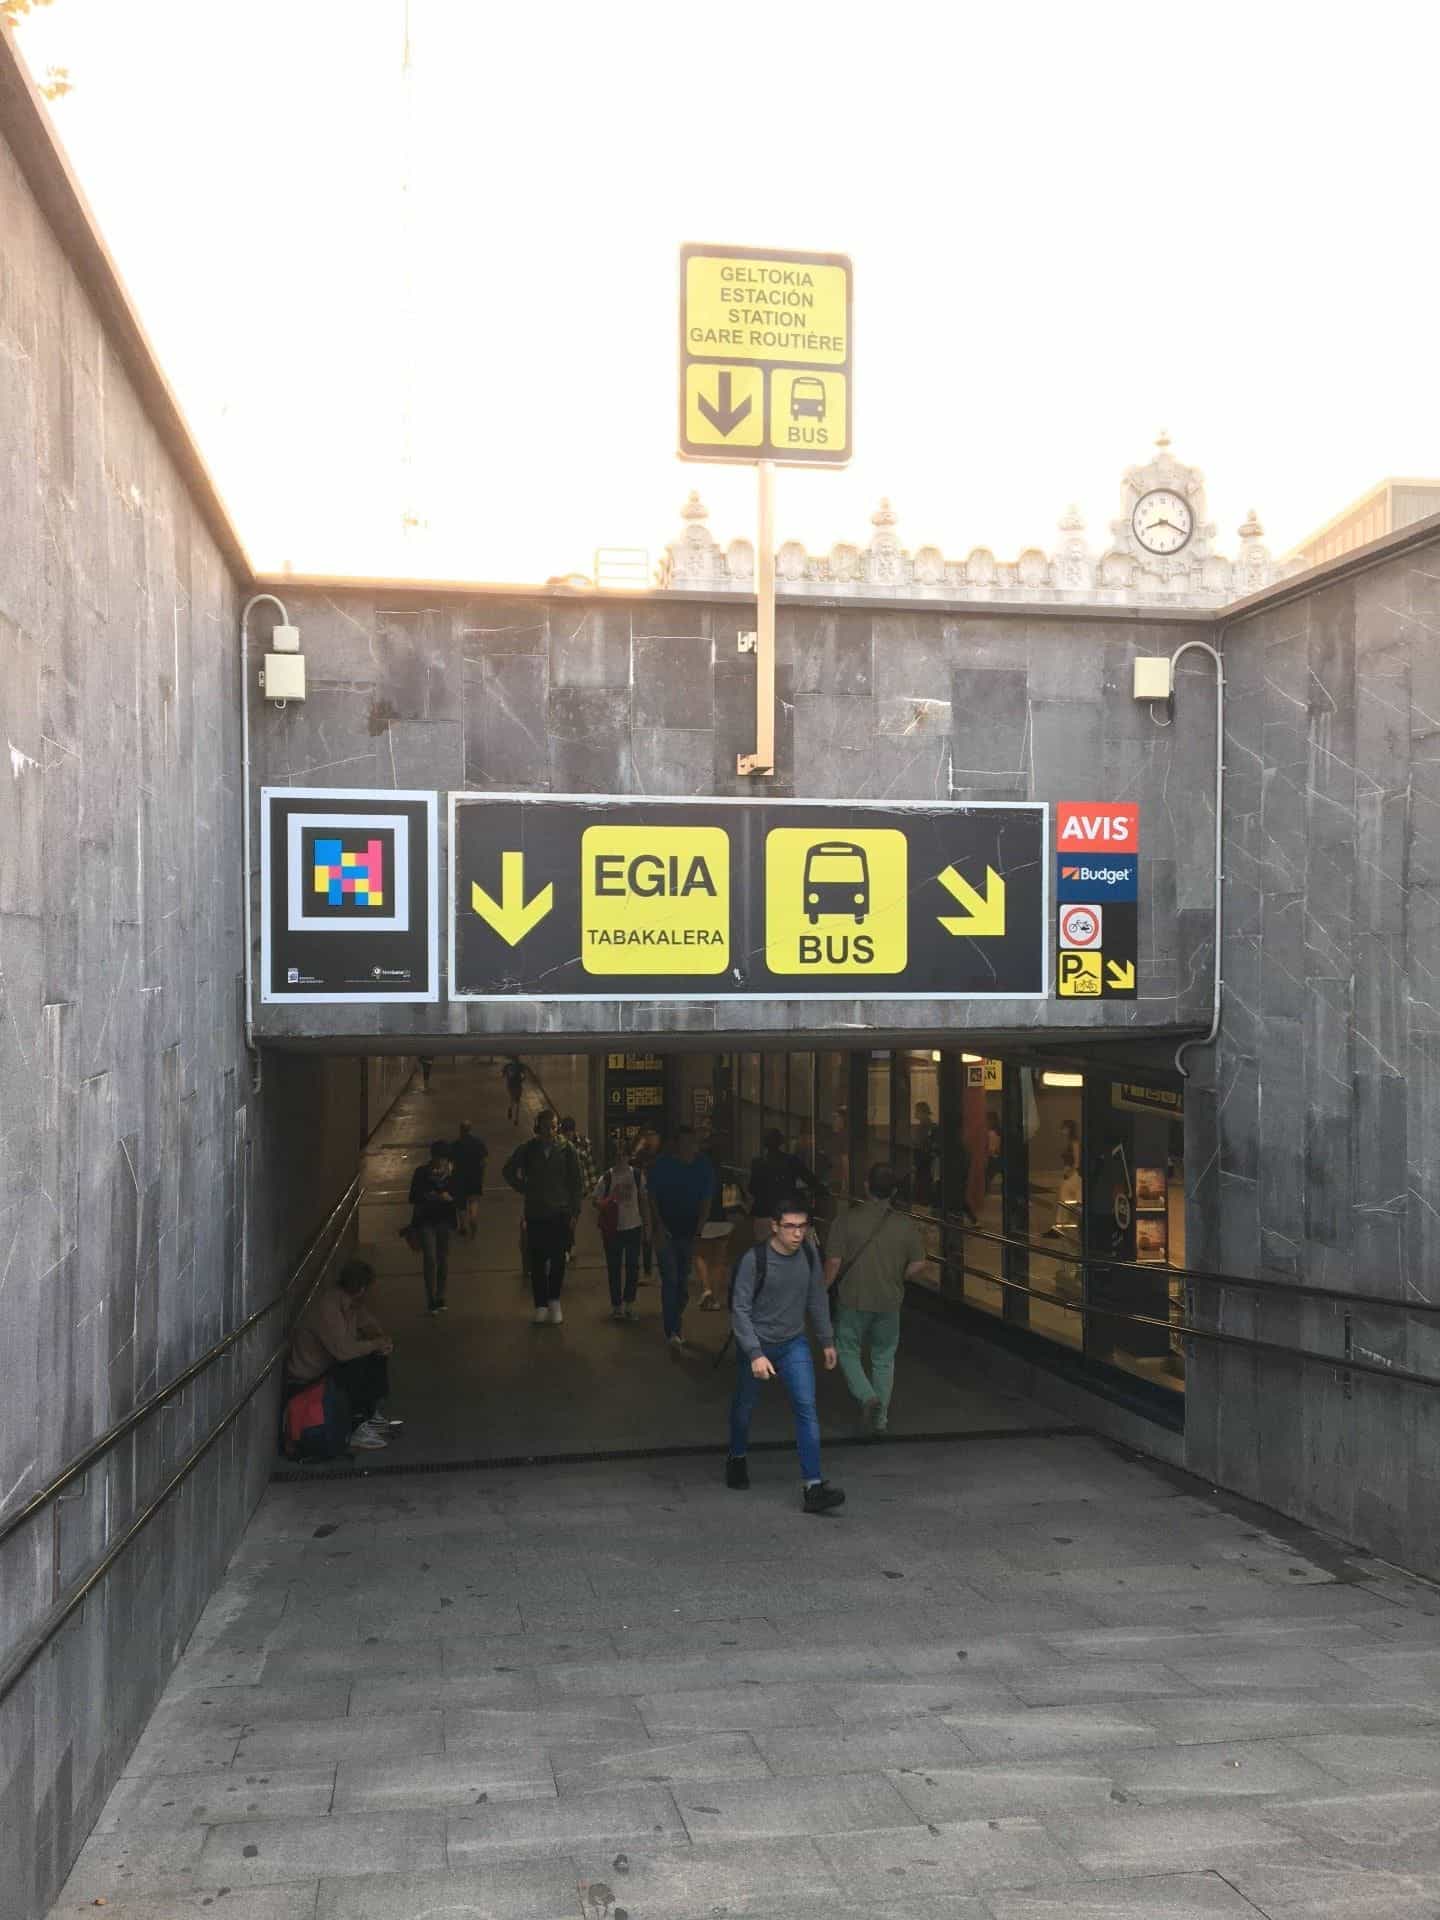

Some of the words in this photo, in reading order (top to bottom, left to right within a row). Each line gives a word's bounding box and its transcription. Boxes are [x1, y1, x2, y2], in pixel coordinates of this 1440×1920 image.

[721, 266, 815, 287] GELTOKIA
[721, 287, 814, 308] ESTACIÓN
[728, 308, 806, 328] STATION
[690, 328, 744, 345] GARE
[788, 427, 828, 444] BUS
[1062, 815, 1129, 841] AVIS
[594, 854, 718, 897] EGIA
[1081, 867, 1130, 884] Budget
[587, 929, 725, 946] TABAKALERA
[798, 935, 875, 965] BUS
[1062, 954, 1083, 984] P
